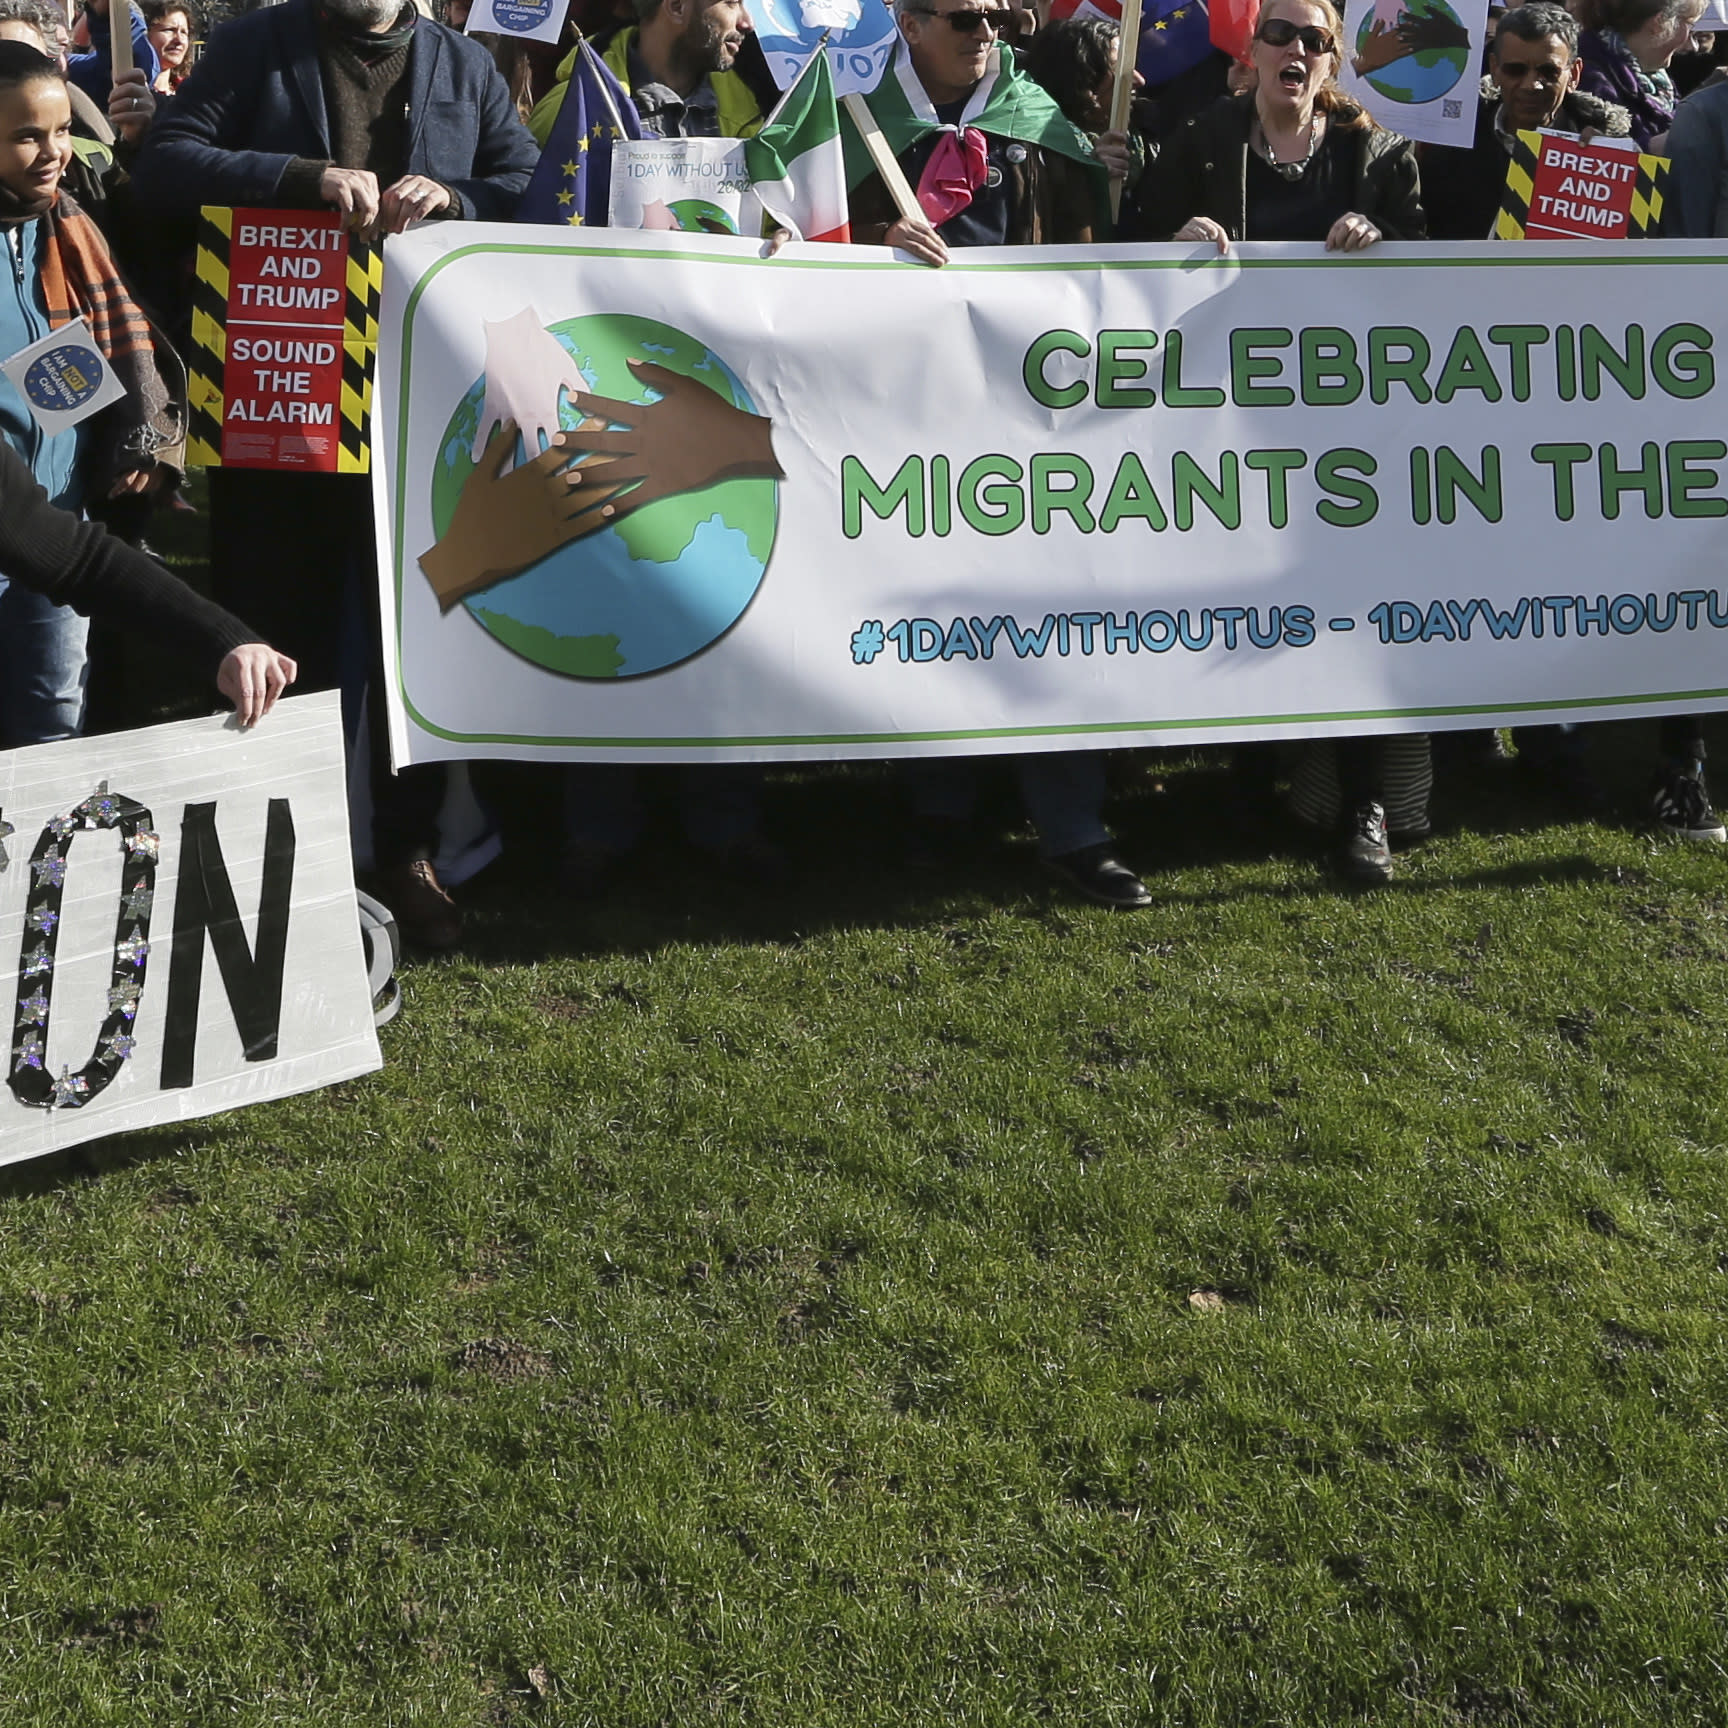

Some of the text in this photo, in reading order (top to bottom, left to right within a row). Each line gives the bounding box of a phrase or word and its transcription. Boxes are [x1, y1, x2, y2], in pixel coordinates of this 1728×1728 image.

[627, 164, 664, 177] 1DAY
[667, 162, 732, 177] WITHOUT
[1544, 149, 1635, 183] BREXIT
[1558, 176, 1611, 202] AND
[1538, 195, 1624, 229] TRUMP
[239, 225, 344, 251] BREXIT
[259, 256, 321, 279] AND
[237, 283, 340, 309] TRUMP
[232, 338, 336, 365] SOUND
[1021, 322, 1717, 412] CELEBRATING
[39, 377, 56, 396] CHIP
[40, 357, 77, 406] BARGAINING
[254, 370, 311, 394] THE
[227, 398, 333, 425] ALARM
[839, 442, 1381, 542] MIGRANTS
[1411, 439, 1502, 527] IN
[849, 604, 1317, 666] #1DAYWITHOUTUS
